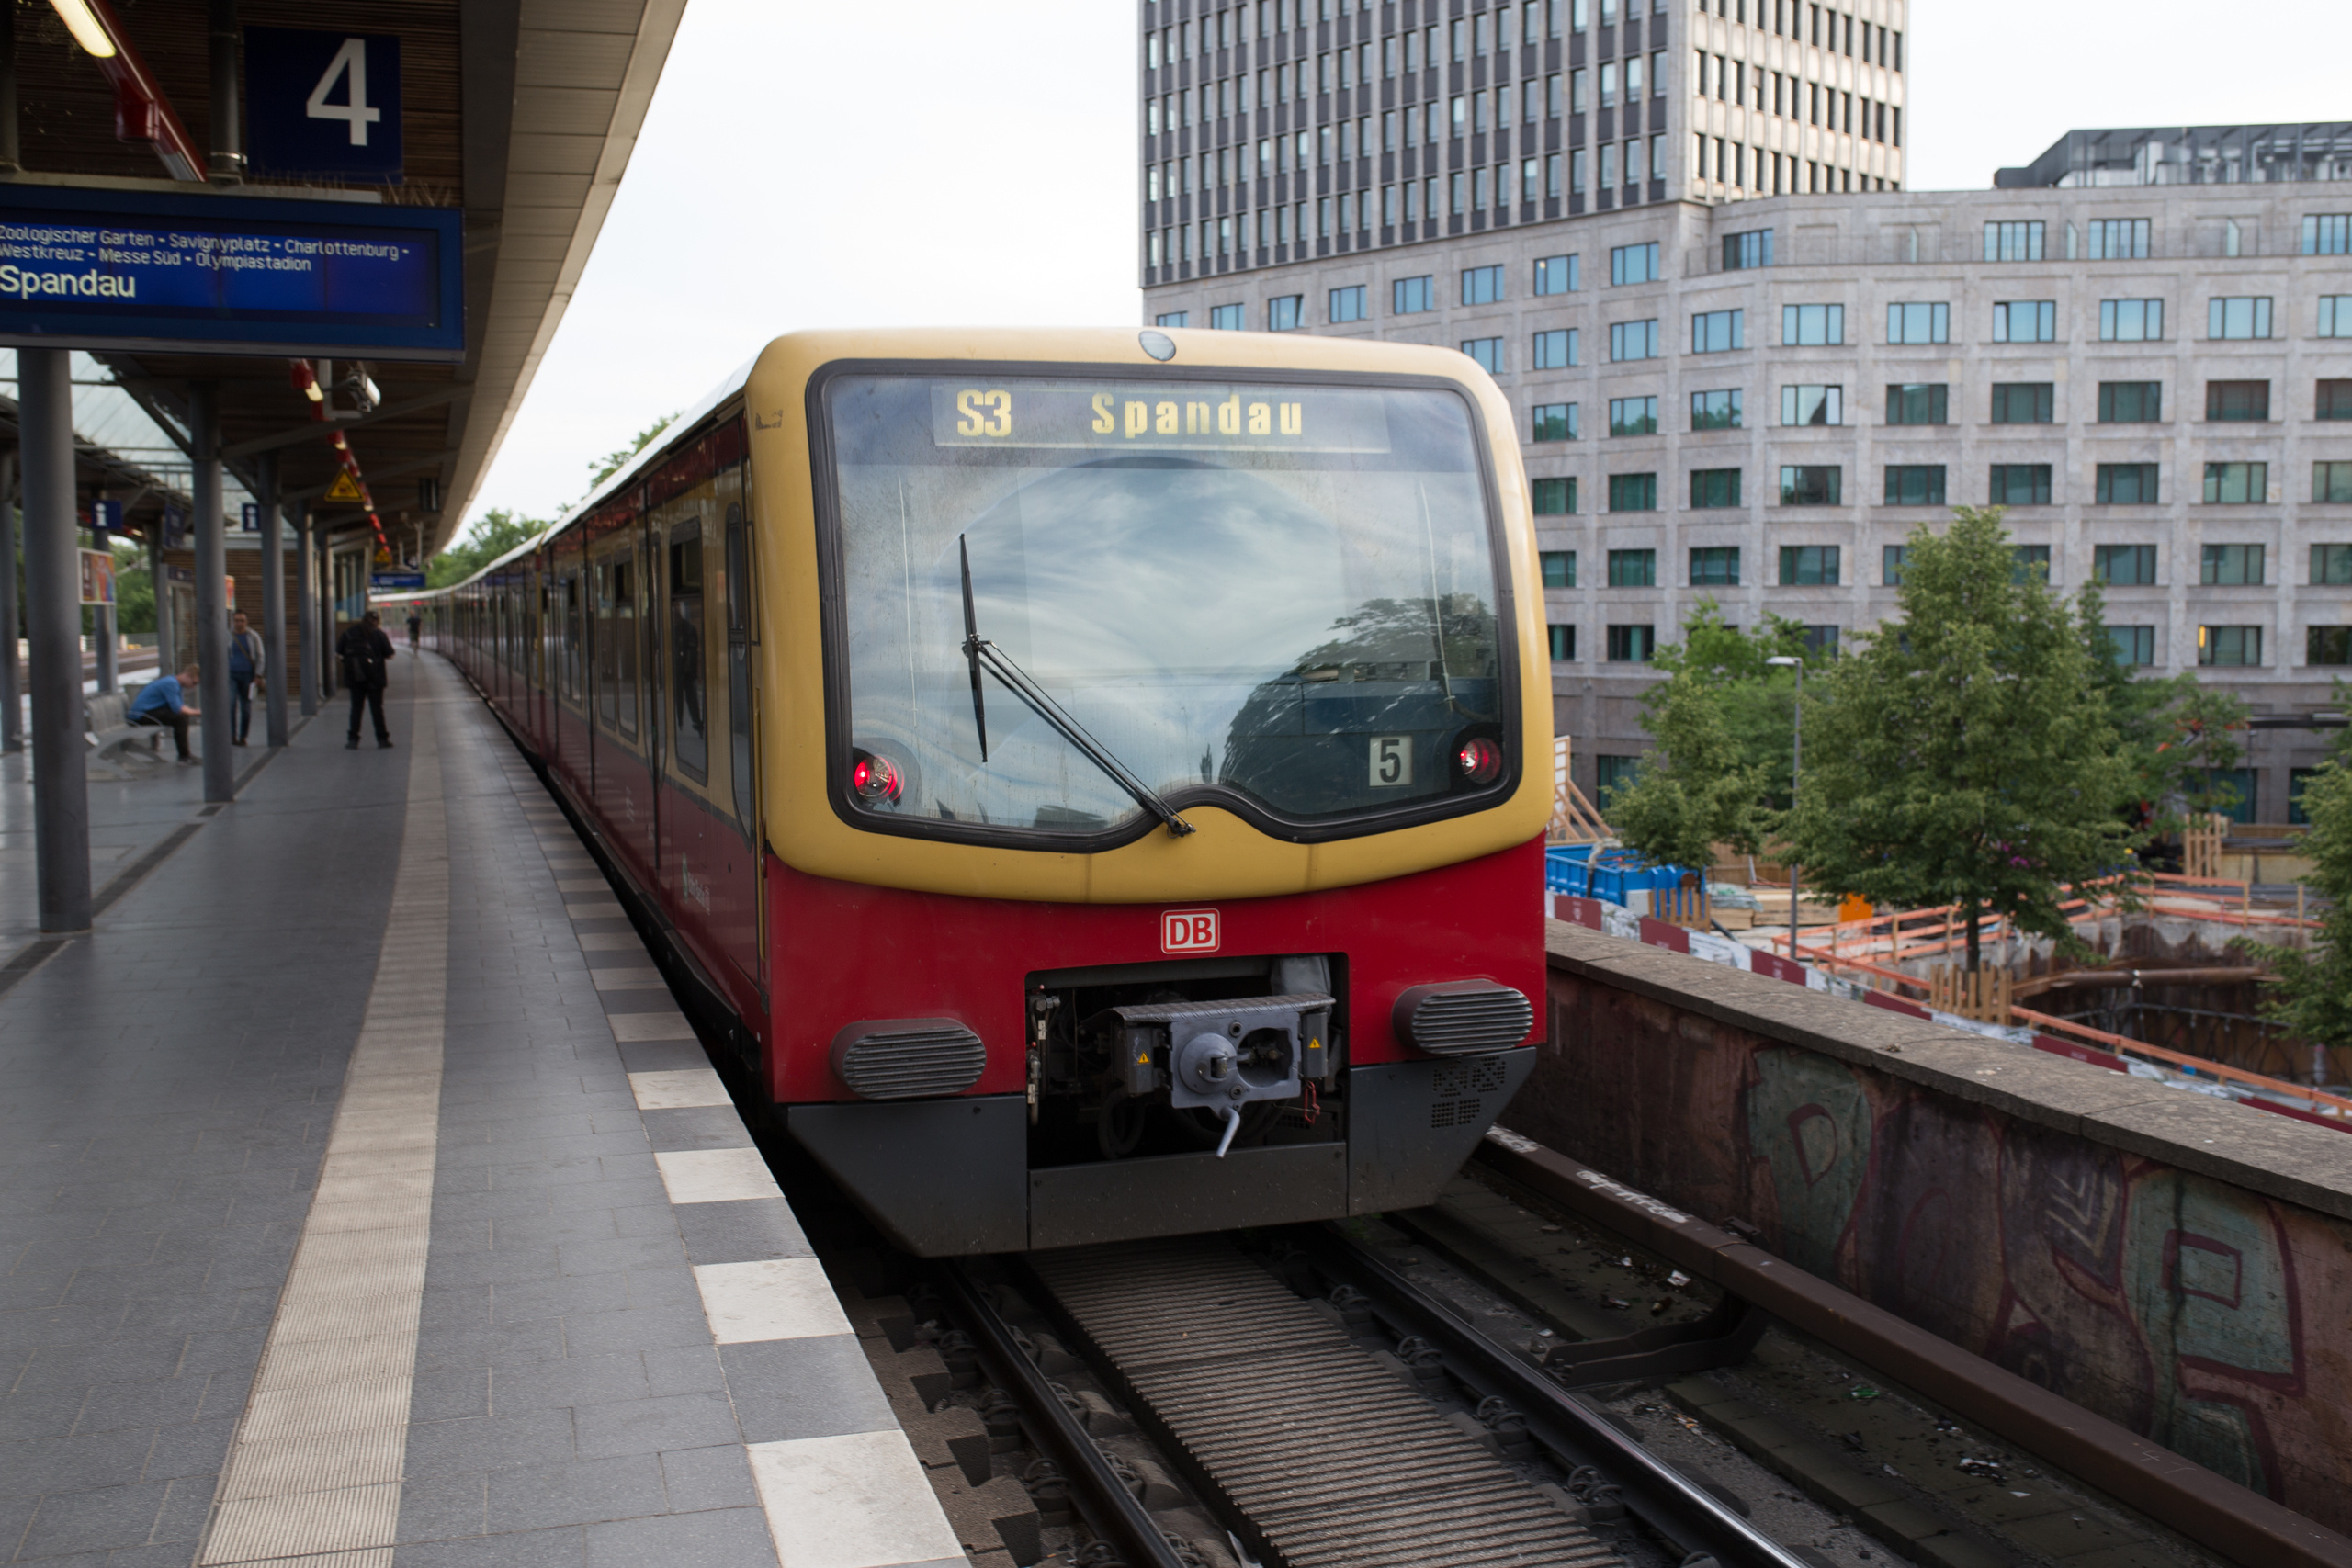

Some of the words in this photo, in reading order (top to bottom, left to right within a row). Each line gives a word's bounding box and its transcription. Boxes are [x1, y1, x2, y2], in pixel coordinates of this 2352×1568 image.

[306, 38, 380, 146] 4
[98, 247, 151, 265] Messe
[153, 250, 181, 266] Süd
[195, 252, 311, 272] Olympiastadion
[99, 230, 154, 246] Garten
[169, 232, 270, 254] Savignyplatz
[284, 239, 399, 261] Charlottenburg
[0, 264, 136, 300] Spandau
[956, 389, 1012, 437] S3
[1091, 392, 1302, 438] Spandau
[1379, 739, 1401, 784] 5
[1170, 917, 1213, 945] DB
